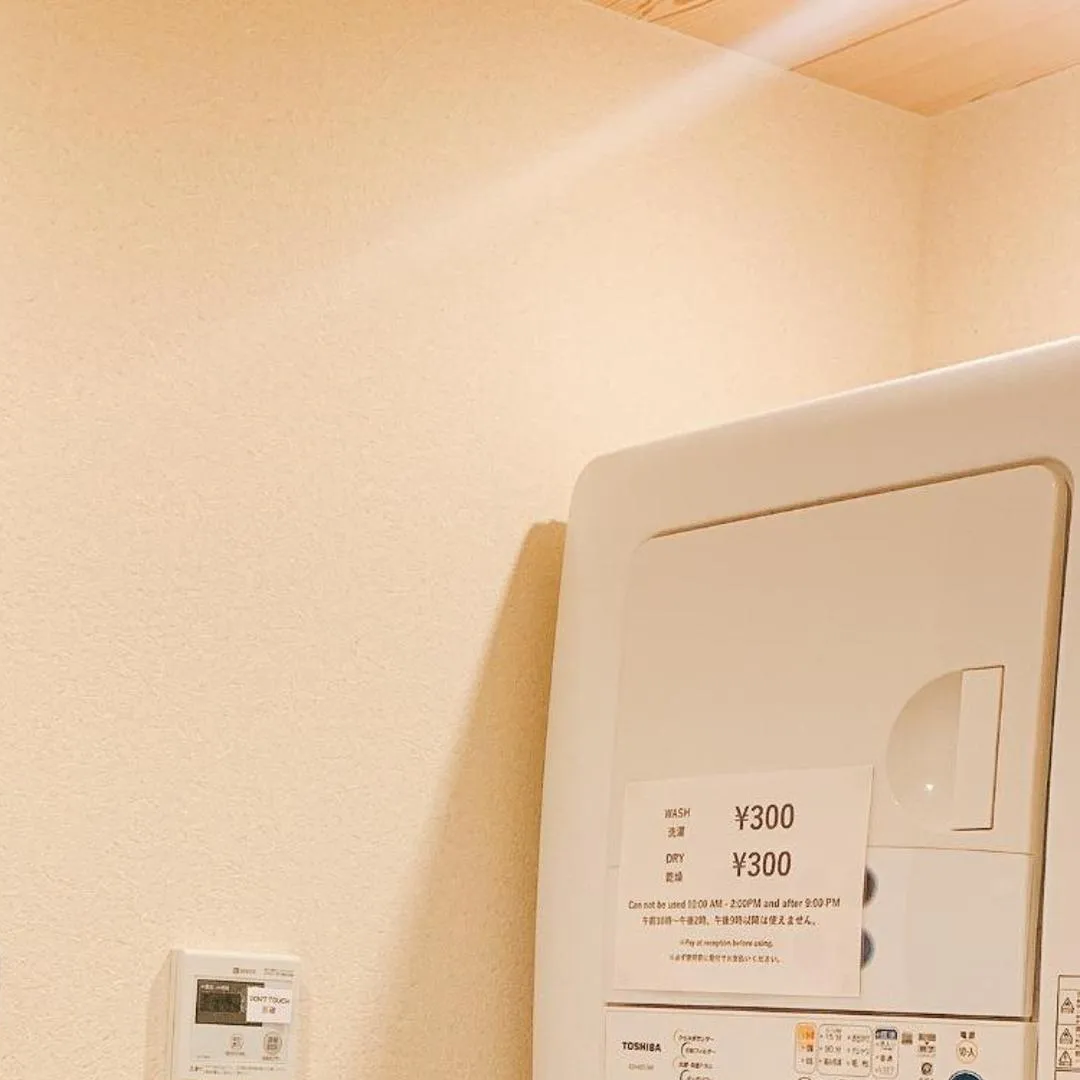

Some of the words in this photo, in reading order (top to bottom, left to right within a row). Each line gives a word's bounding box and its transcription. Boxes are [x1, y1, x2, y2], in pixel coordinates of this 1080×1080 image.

[665, 807, 691, 819] WASH
[735, 803, 795, 830] ¥300
[666, 852, 685, 864] DRY
[732, 850, 792, 877] ¥300
[628, 900, 642, 909] Can
[644, 900, 655, 909] not
[657, 900, 666, 909] be
[709, 899, 723, 908] AM
[763, 898, 780, 908] and
[782, 898, 803, 908] after
[825, 897, 841, 908] PM
[622, 1041, 662, 1053] TOSHIBA
